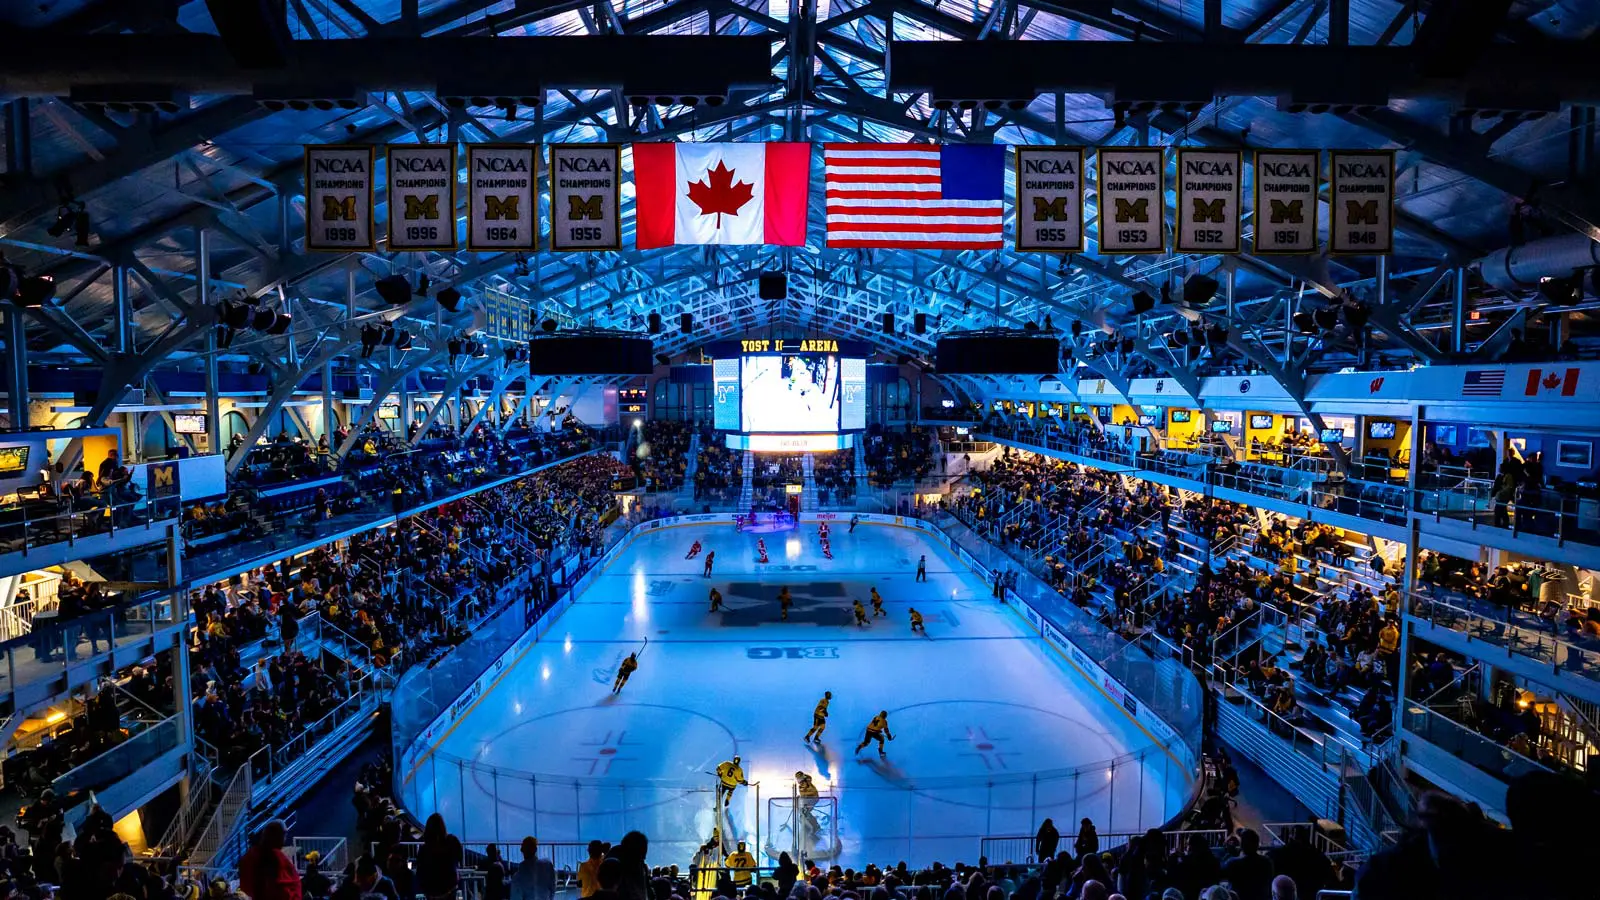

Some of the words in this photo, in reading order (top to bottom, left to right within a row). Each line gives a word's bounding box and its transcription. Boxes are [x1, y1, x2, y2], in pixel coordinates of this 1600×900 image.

[314, 158, 365, 174] NCAA
[395, 158, 447, 173] NCAA
[476, 158, 528, 173] NCAA
[559, 158, 612, 173] NCAA
[1025, 159, 1075, 175] NCAA
[1106, 160, 1156, 176] NCAA
[1185, 160, 1234, 176] NCAA
[1263, 162, 1311, 178] NCAA
[1338, 163, 1386, 178] NCAA
[315, 180, 364, 189] CHAMPIONS
[396, 179, 446, 188] CHAMPIONS
[476, 179, 527, 188] CHAMPIONS
[560, 179, 611, 188] CHAMPIONS
[1025, 181, 1075, 190] CHAMPIONS
[1107, 182, 1156, 191] CHAMPIONS
[1185, 182, 1232, 192] CHAMPIONS
[1264, 183, 1310, 193] CHAMPIONS
[1339, 184, 1385, 194] CHAMPIONS
[323, 195, 356, 221] M
[404, 195, 438, 219] M
[485, 195, 519, 220] M
[568, 195, 603, 220] M
[1033, 197, 1067, 221] M
[1115, 198, 1149, 223] M
[1193, 197, 1226, 223] M
[1270, 199, 1303, 224] M
[1346, 200, 1378, 224] M
[325, 228, 356, 241] 1998
[406, 227, 438, 240] 1996
[486, 227, 517, 241] 1964
[570, 227, 602, 241] 1956
[1035, 228, 1066, 242] 1955
[1118, 229, 1148, 243] 1953
[1194, 230, 1223, 243] 1952
[1274, 230, 1299, 244] 1951
[741, 340, 770, 352] YOST
[800, 340, 839, 352] ARENA
[154, 466, 174, 489] M
[727, 767, 735, 778] 6
